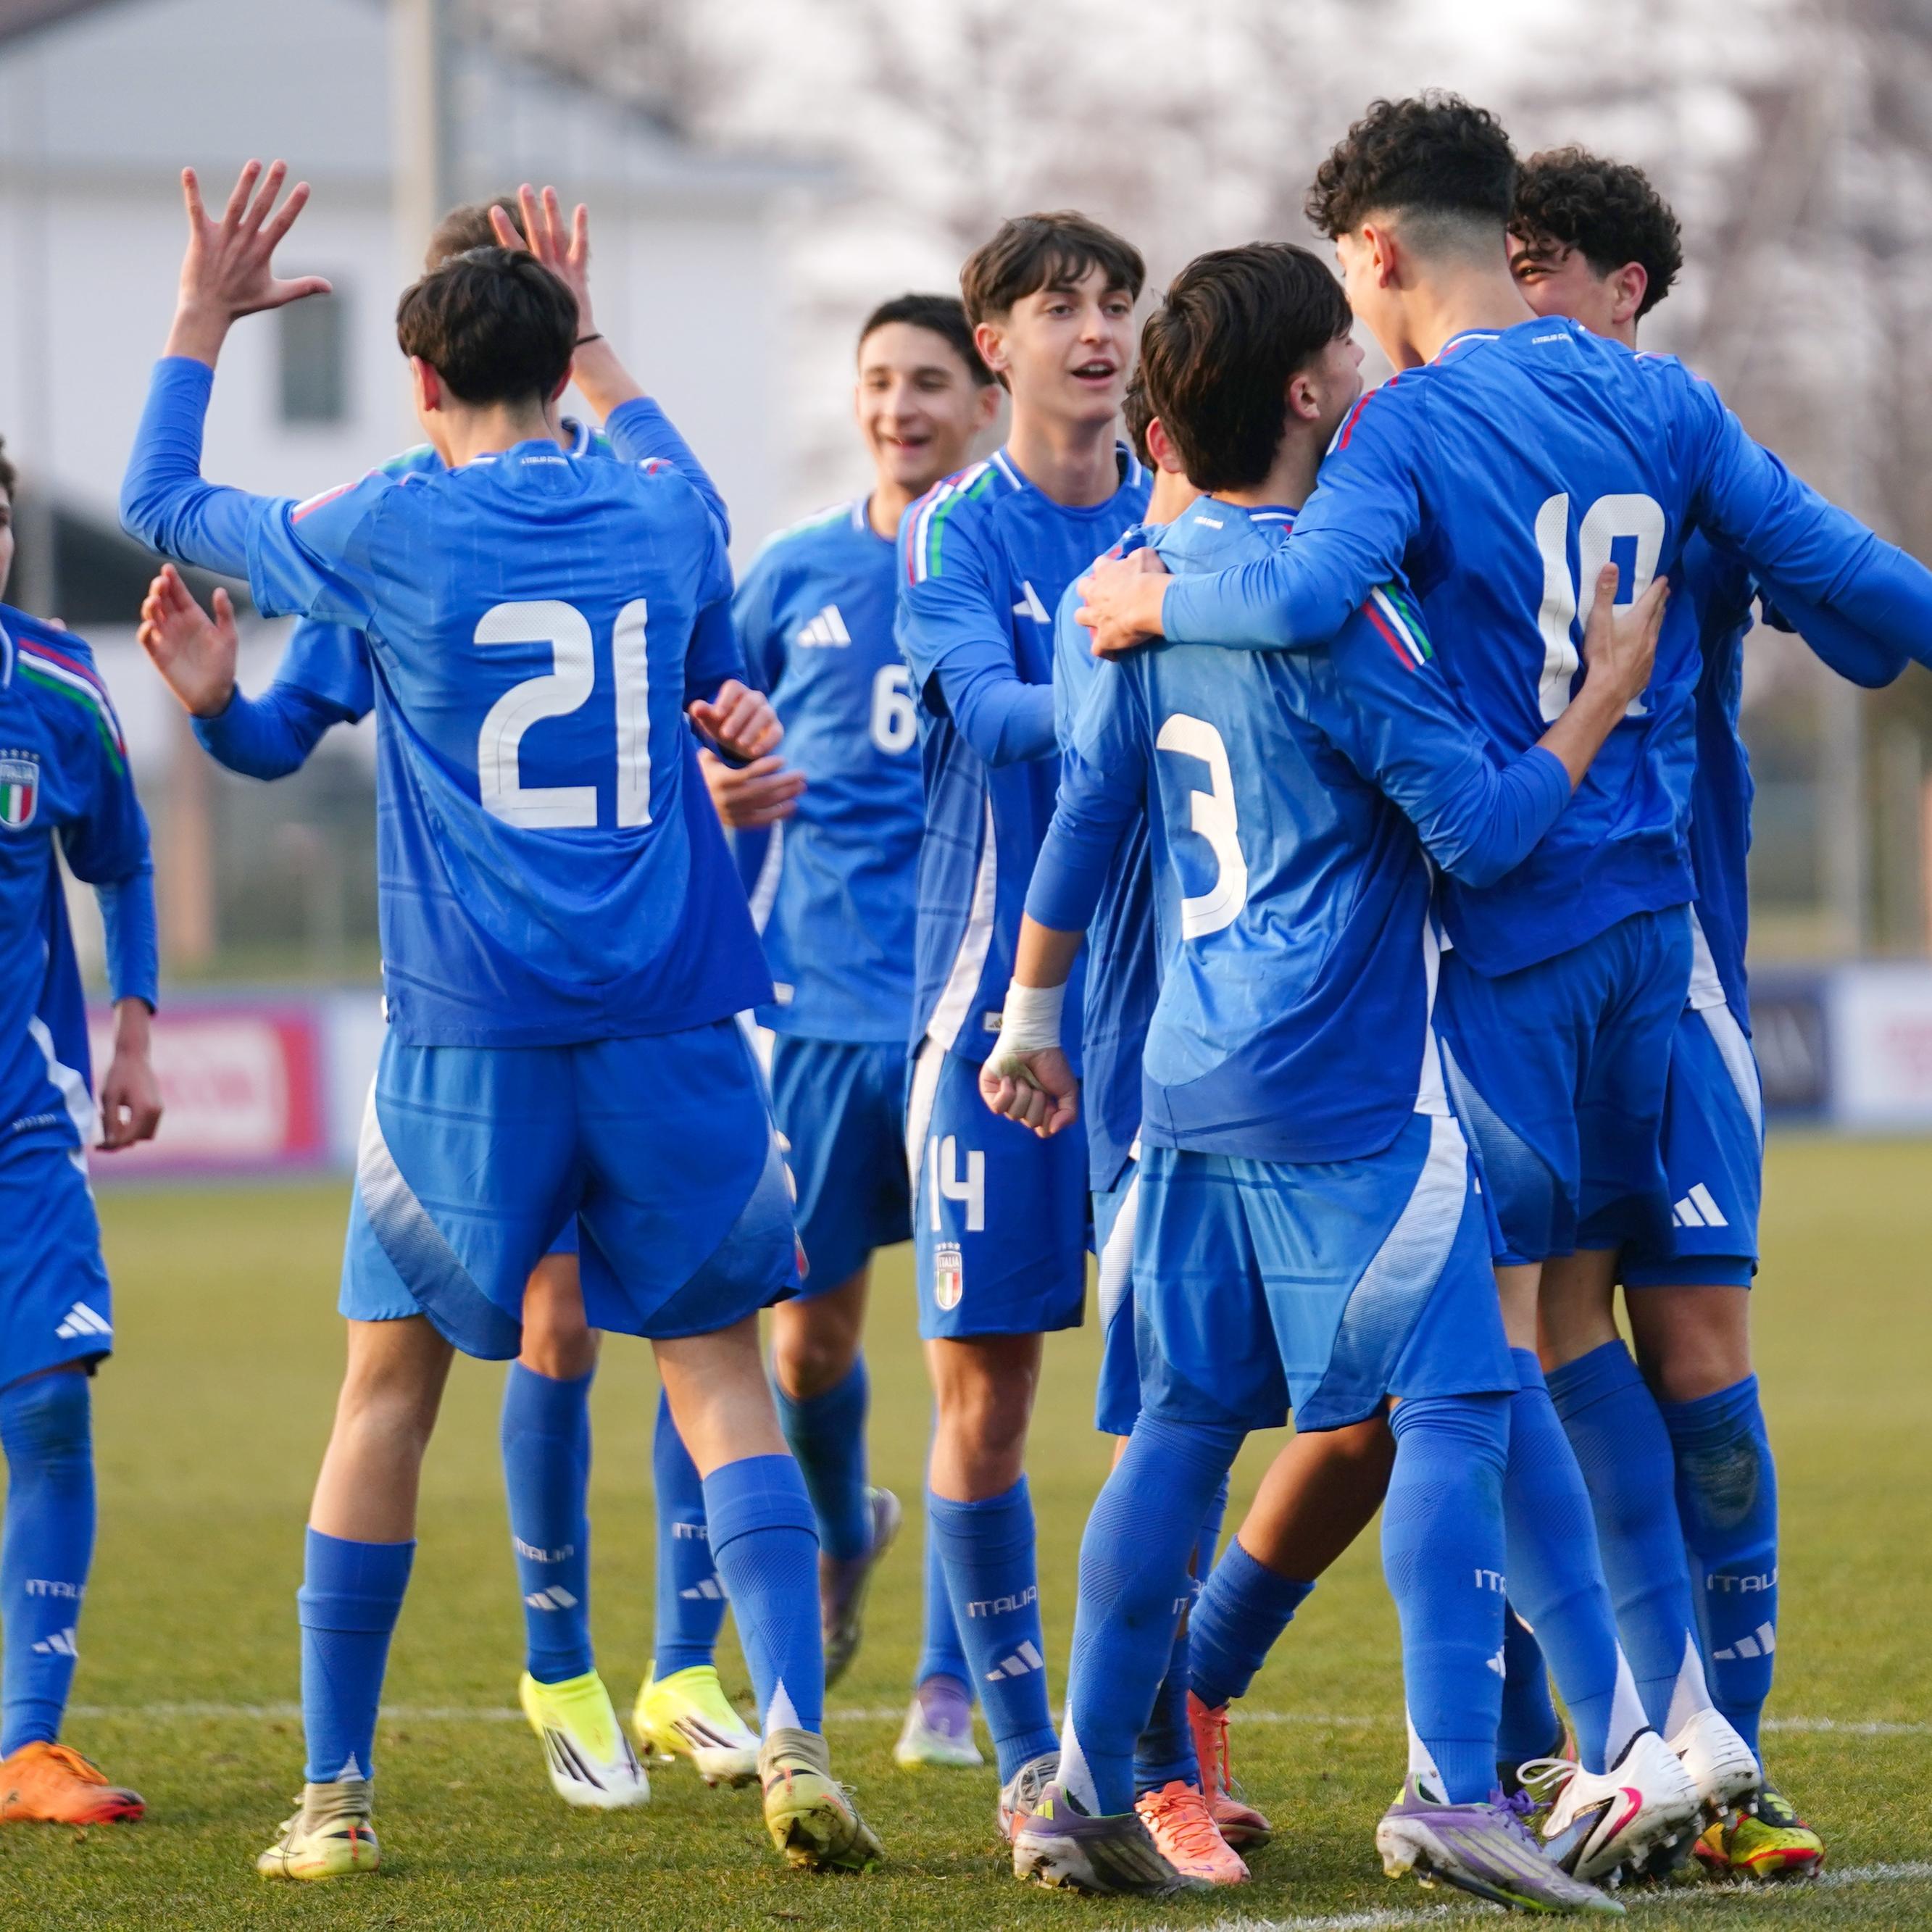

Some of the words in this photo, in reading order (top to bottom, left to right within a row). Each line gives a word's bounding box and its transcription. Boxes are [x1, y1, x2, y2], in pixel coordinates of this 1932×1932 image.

[473, 598, 652, 829] 21
[872, 664, 917, 754] 6
[1156, 713, 1248, 941] 3
[928, 1135, 985, 1231] 14
[938, 1256, 960, 1268] ITALIA
[968, 1586, 1037, 1618] ITALIA
[1707, 1568, 1776, 1593] ITALI
